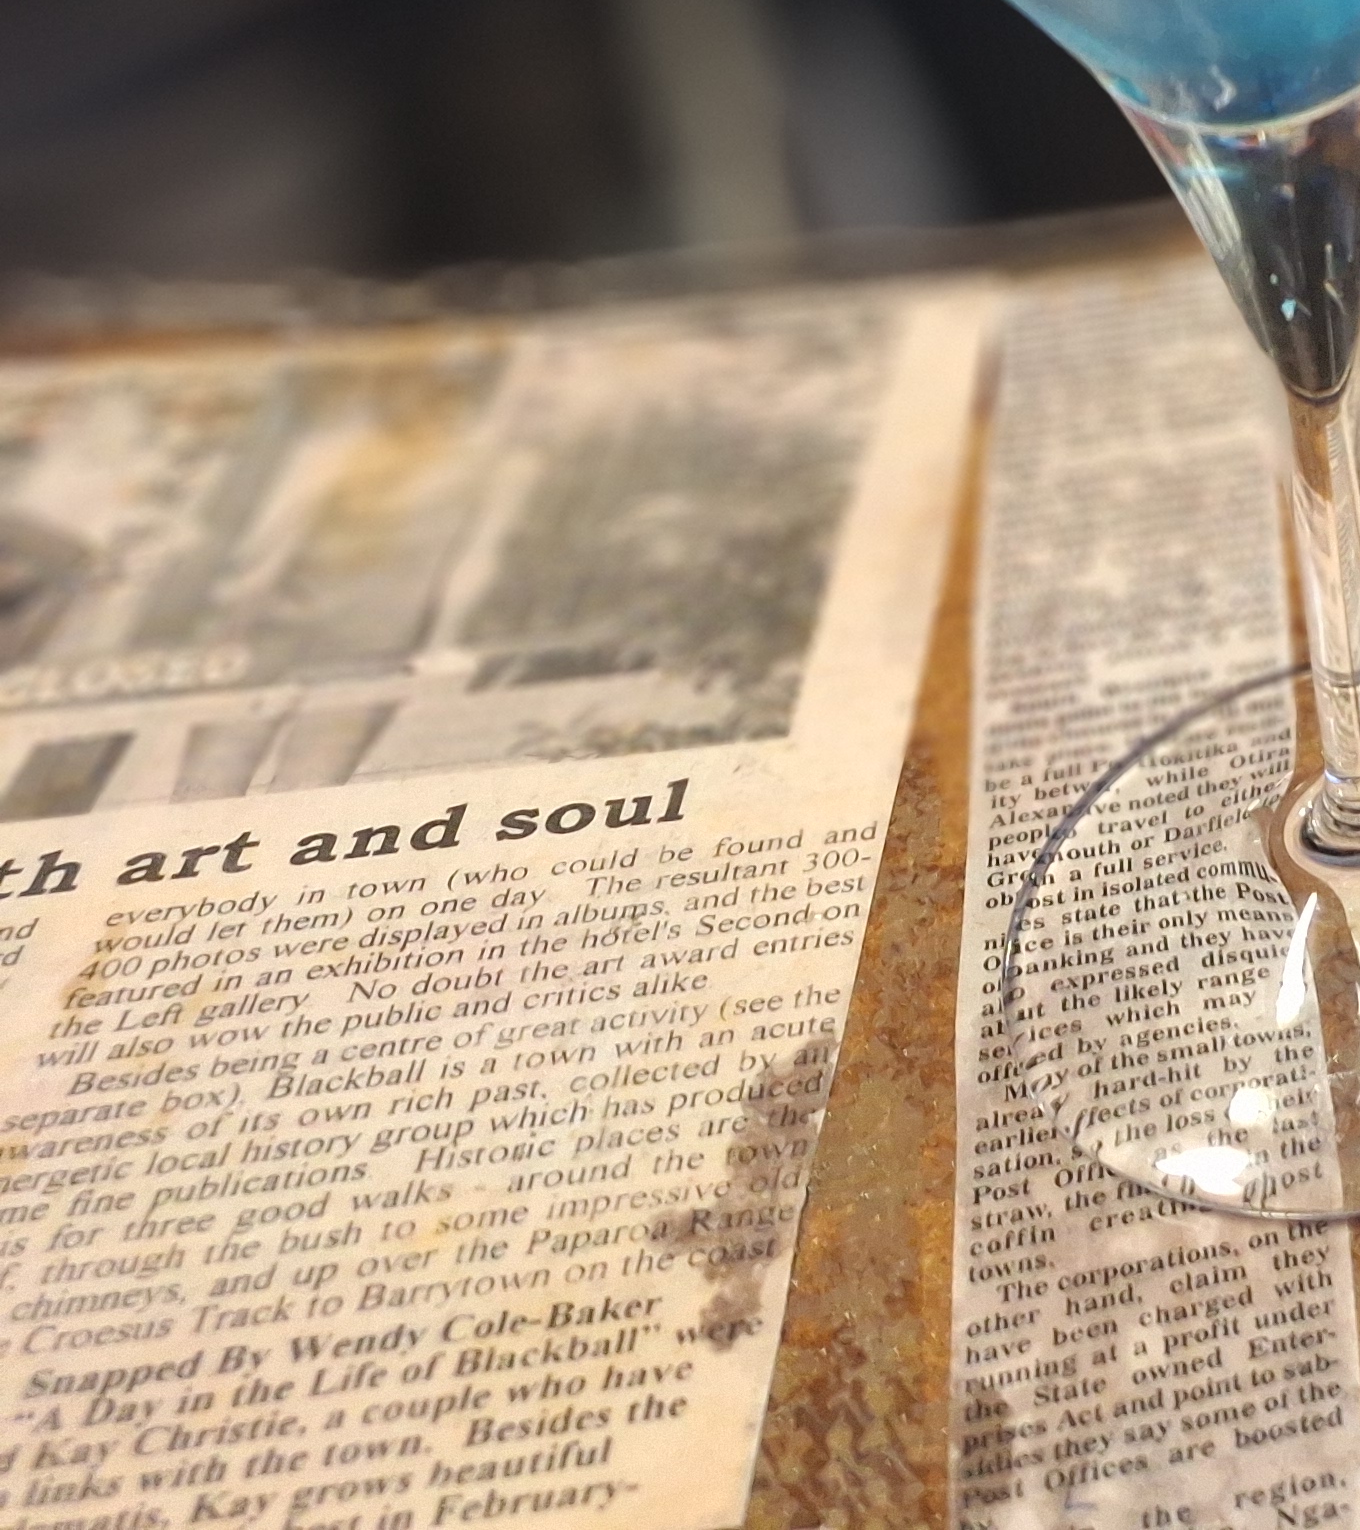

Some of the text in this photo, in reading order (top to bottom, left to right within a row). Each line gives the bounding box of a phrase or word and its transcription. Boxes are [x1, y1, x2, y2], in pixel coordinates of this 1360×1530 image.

[105, 821, 877, 927] everybody in town (who could be found and
[117, 831, 260, 886] art
[289, 803, 468, 867] and
[495, 779, 690, 843] soul
[77, 956, 142, 980] 400
[146, 947, 260, 979] photos
[273, 937, 349, 957] were
[358, 913, 507, 955] displayed
[516, 910, 544, 930] in
[683, 886, 739, 911] and
[749, 883, 796, 903] the
[805, 876, 863, 897] best
[94, 923, 196, 953] would
[205, 920, 247, 941] let
[261, 908, 353, 934] them)
[366, 904, 405, 922] on
[419, 897, 476, 916] one
[588, 875, 641, 896] The
[656, 859, 787, 889] resultant
[803, 848, 870, 872] 300-
[48, 931, 853, 1039] the Left gallery No doubt the art award entries
[64, 974, 202, 1009] featured
[212, 971, 243, 992] in
[254, 968, 293, 987] an
[306, 948, 463, 980] exhibition
[477, 943, 505, 960] in
[519, 934, 567, 956] the
[580, 920, 680, 949] hotel's
[36, 1041, 99, 1068] will
[106, 1036, 174, 1060] also
[189, 1026, 268, 1048] wow
[280, 1017, 332, 1038] the
[340, 1004, 441, 1036] public
[452, 992, 511, 1018] and
[522, 984, 620, 1010] critics
[965, 1309, 1040, 1338] other
[1065, 1284, 1142, 1316] hand,
[1272, 1246, 1329, 1271] they
[996, 1217, 1330, 1302] The corporations, on the
[965, 1269, 1332, 1364] have been charged with
[965, 1299, 1333, 1394] running at a profit under
[964, 1328, 1335, 1422] the State owned Enter-
